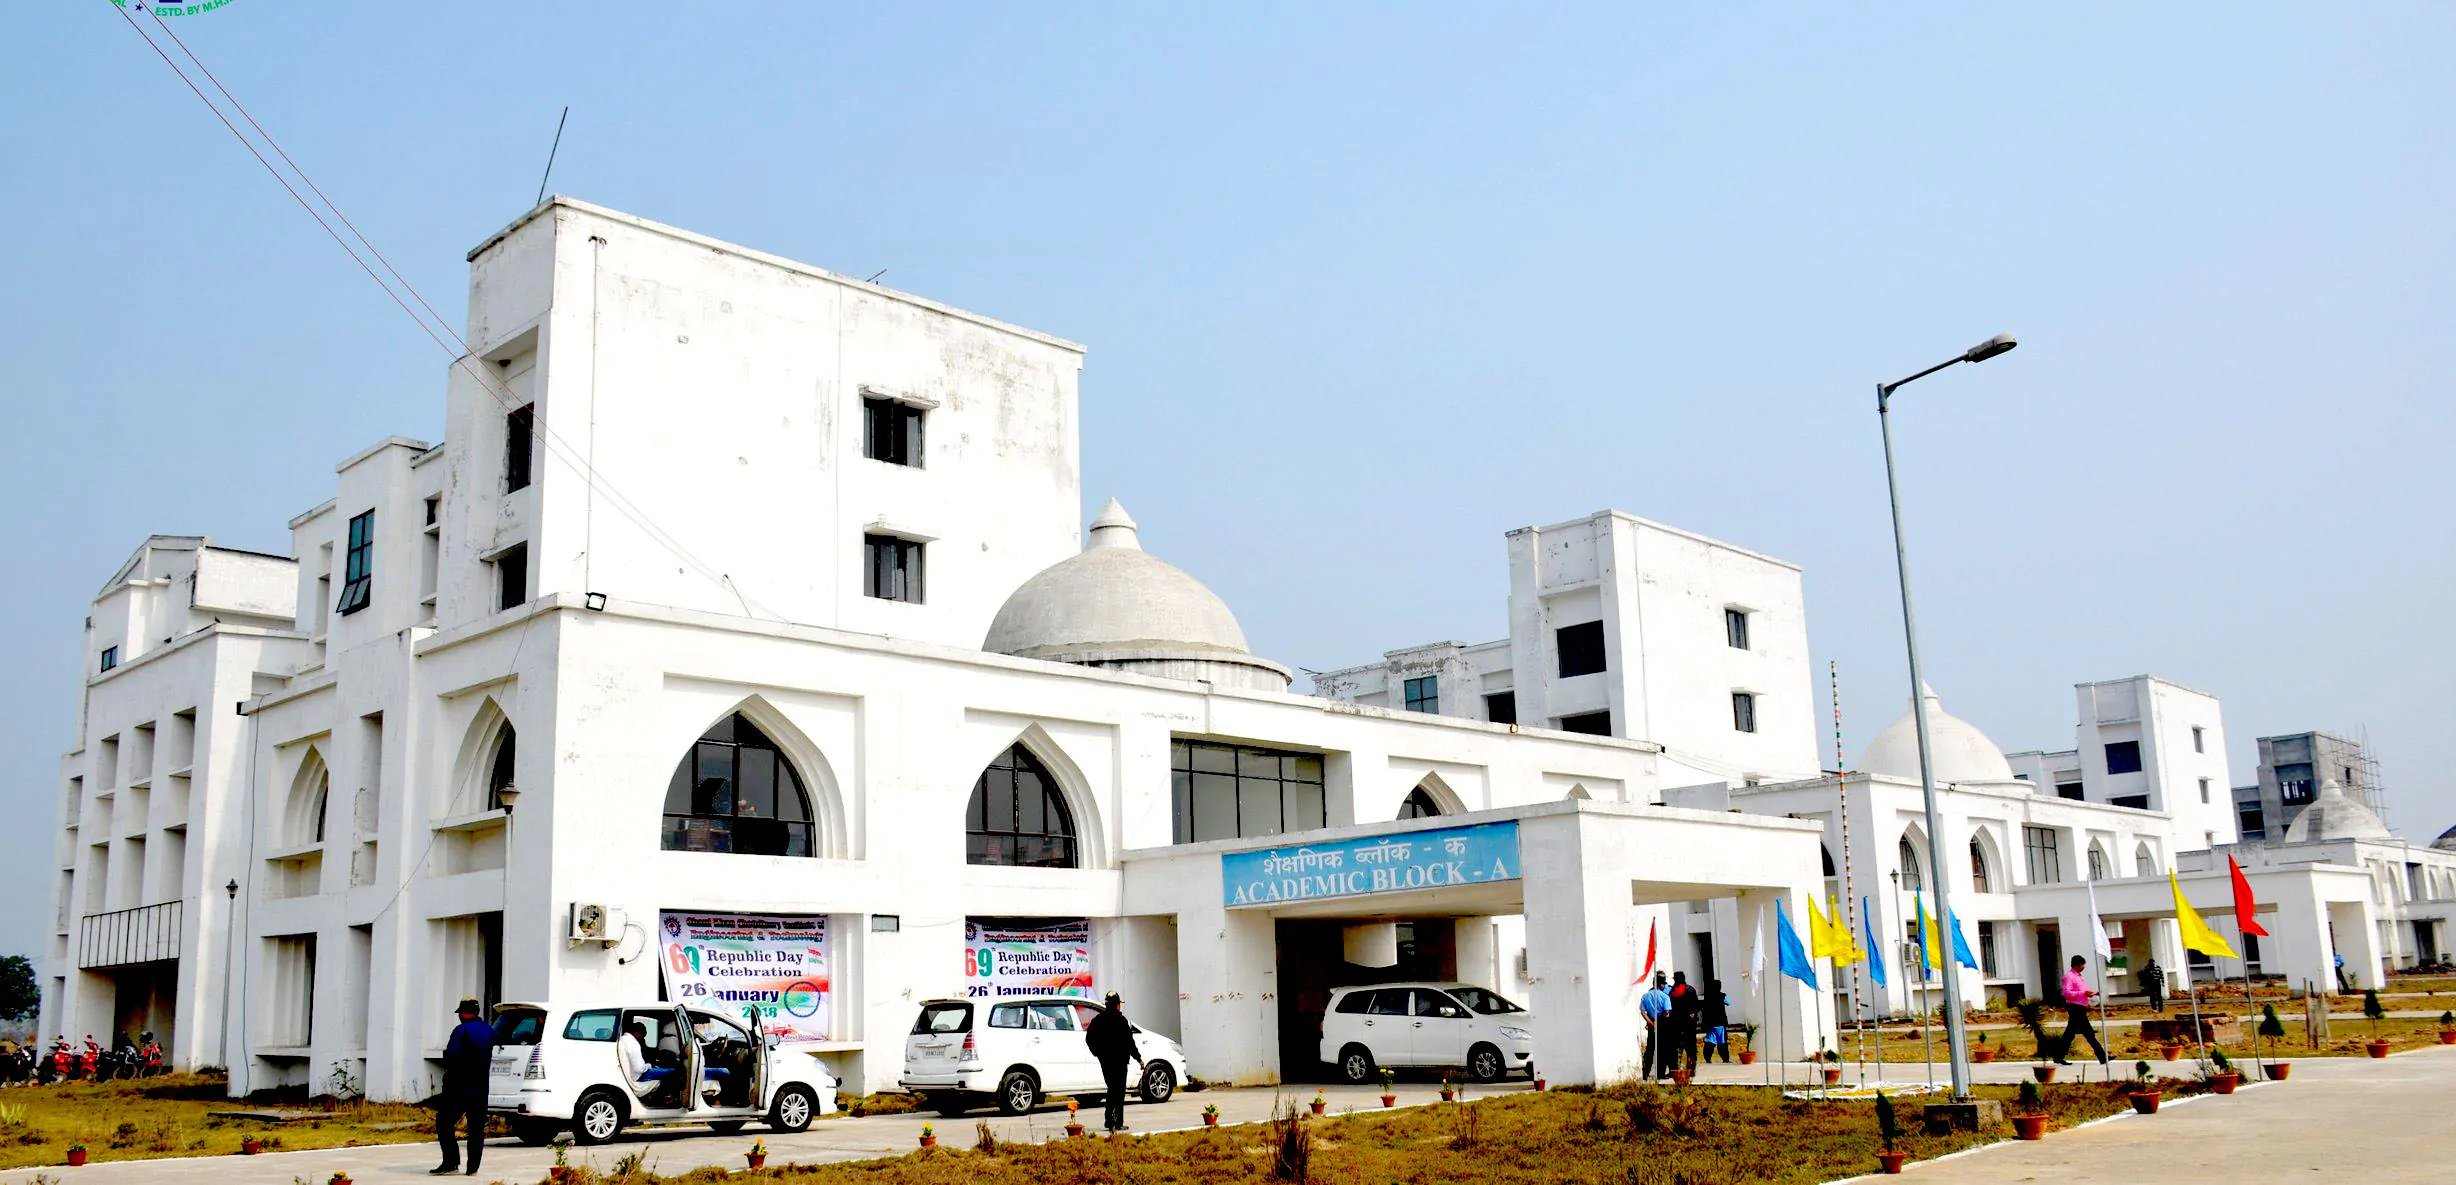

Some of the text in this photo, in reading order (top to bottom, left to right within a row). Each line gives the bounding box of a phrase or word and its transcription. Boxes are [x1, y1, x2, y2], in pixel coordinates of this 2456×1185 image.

[1263, 848, 1344, 876] शैक्षणिक
[1354, 839, 1412, 863] ब्लॉक
[1443, 836, 1467, 855] क
[1231, 873, 1366, 905] ACADEMIC
[1371, 860, 1466, 892] BLOCK
[1490, 857, 1510, 880] A
[706, 949, 772, 965] Republic
[776, 950, 803, 965] Day
[998, 951, 1050, 965] Republic
[1053, 951, 1073, 964] Day
[708, 966, 802, 977] Celebration
[999, 966, 1072, 975] Celebration
